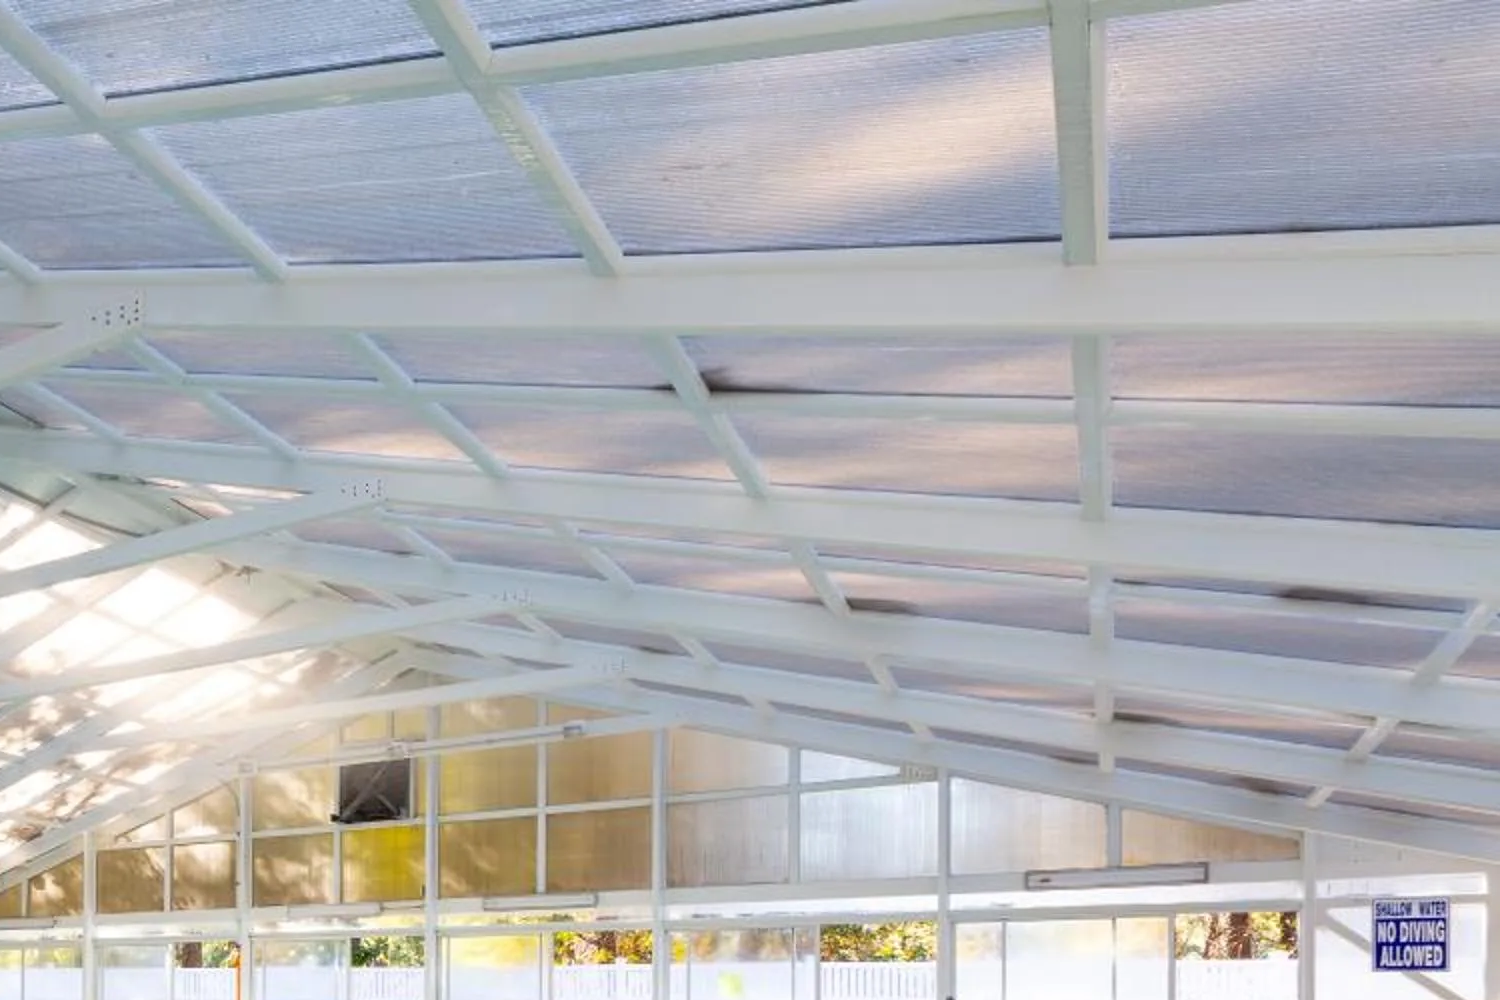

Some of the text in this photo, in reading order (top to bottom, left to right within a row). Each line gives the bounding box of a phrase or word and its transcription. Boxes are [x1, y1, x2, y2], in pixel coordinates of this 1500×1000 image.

[1375, 901, 1446, 917] SHALLOW WATER
[1377, 921, 1445, 943] NO DIVING
[1380, 945, 1443, 967] ALLOWED
